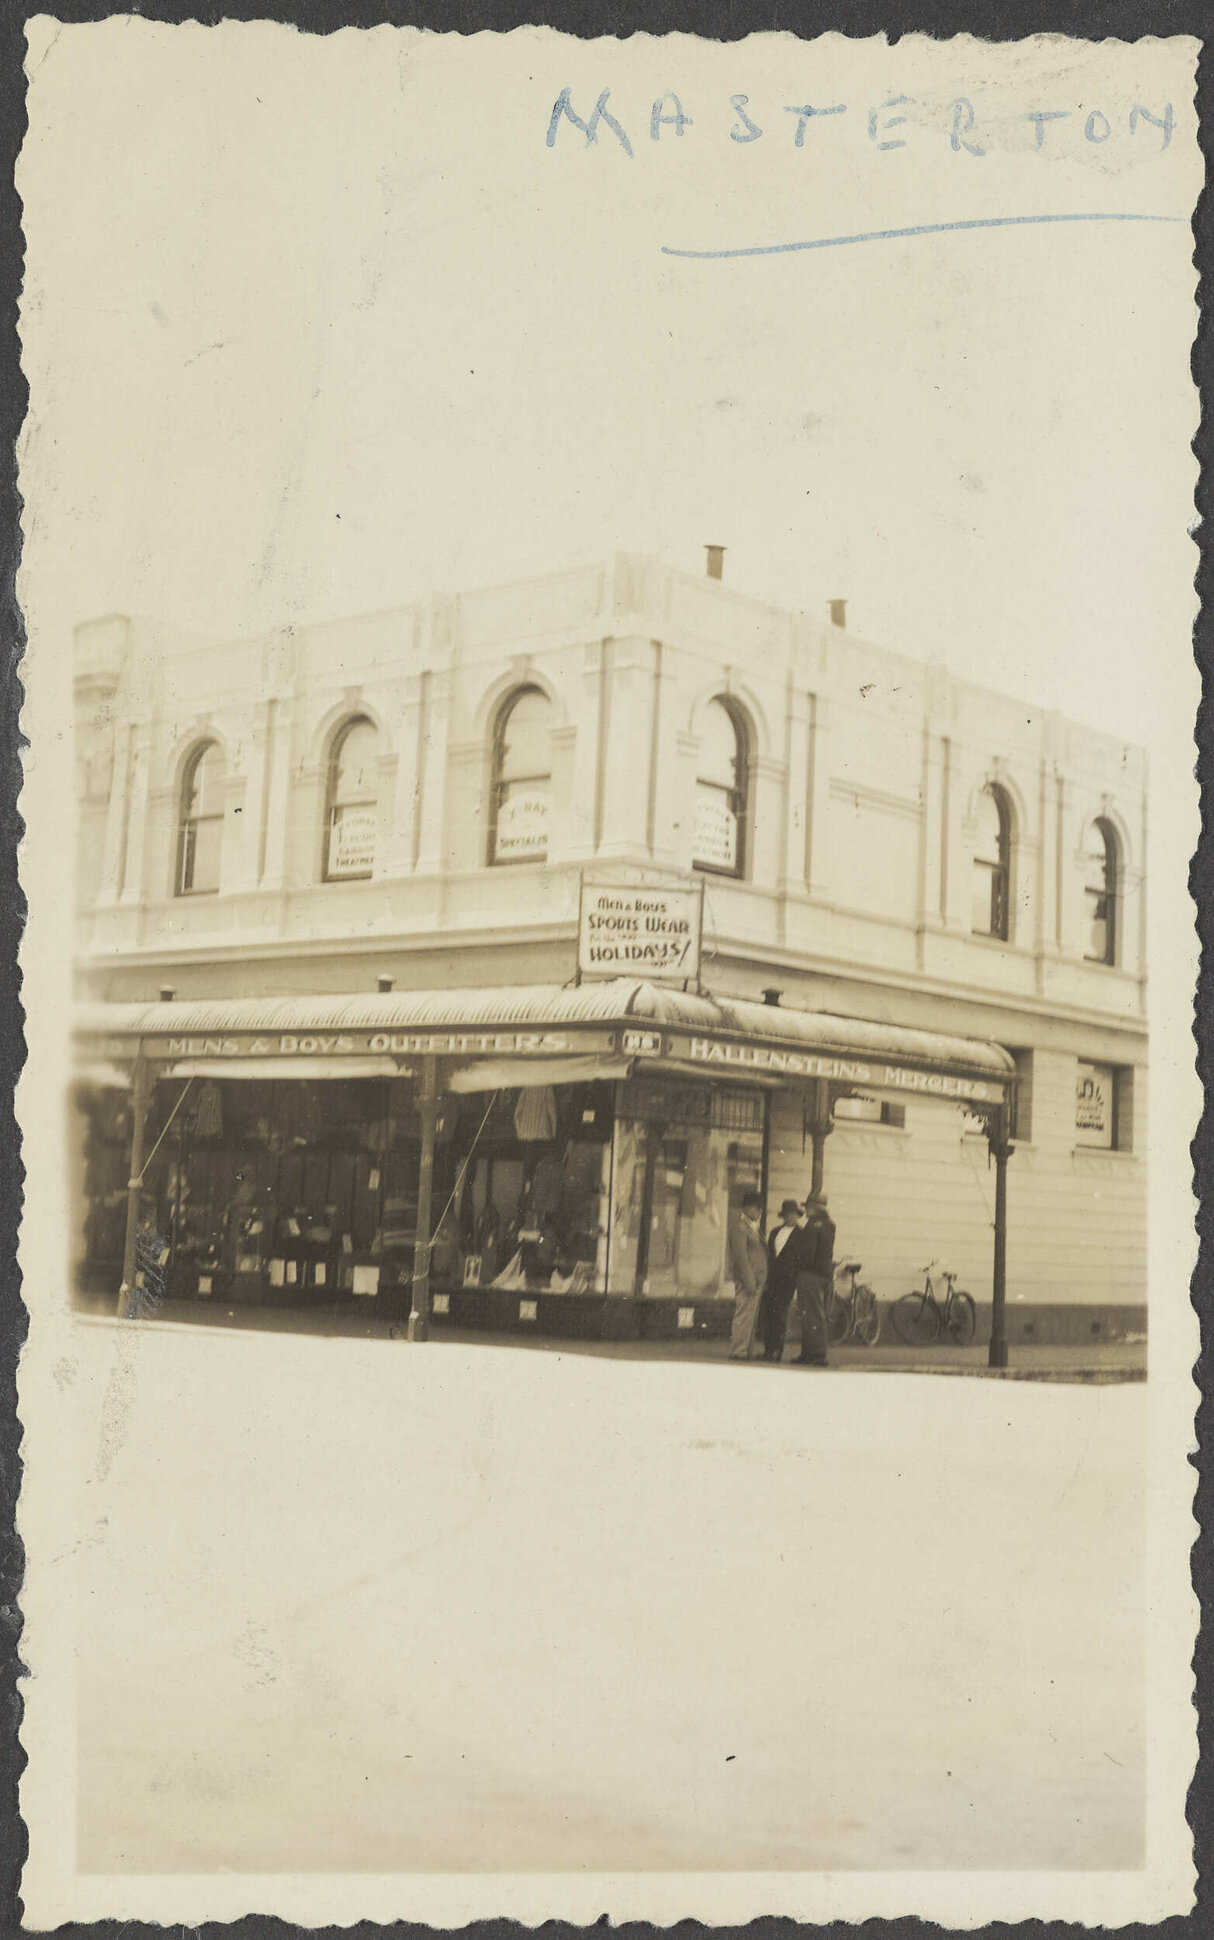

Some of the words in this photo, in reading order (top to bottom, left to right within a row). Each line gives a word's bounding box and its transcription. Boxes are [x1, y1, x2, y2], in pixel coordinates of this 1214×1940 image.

[546, 87, 1177, 157] MASTERTON
[588, 913, 639, 931] SPORTS
[250, 1036, 270, 1055] &
